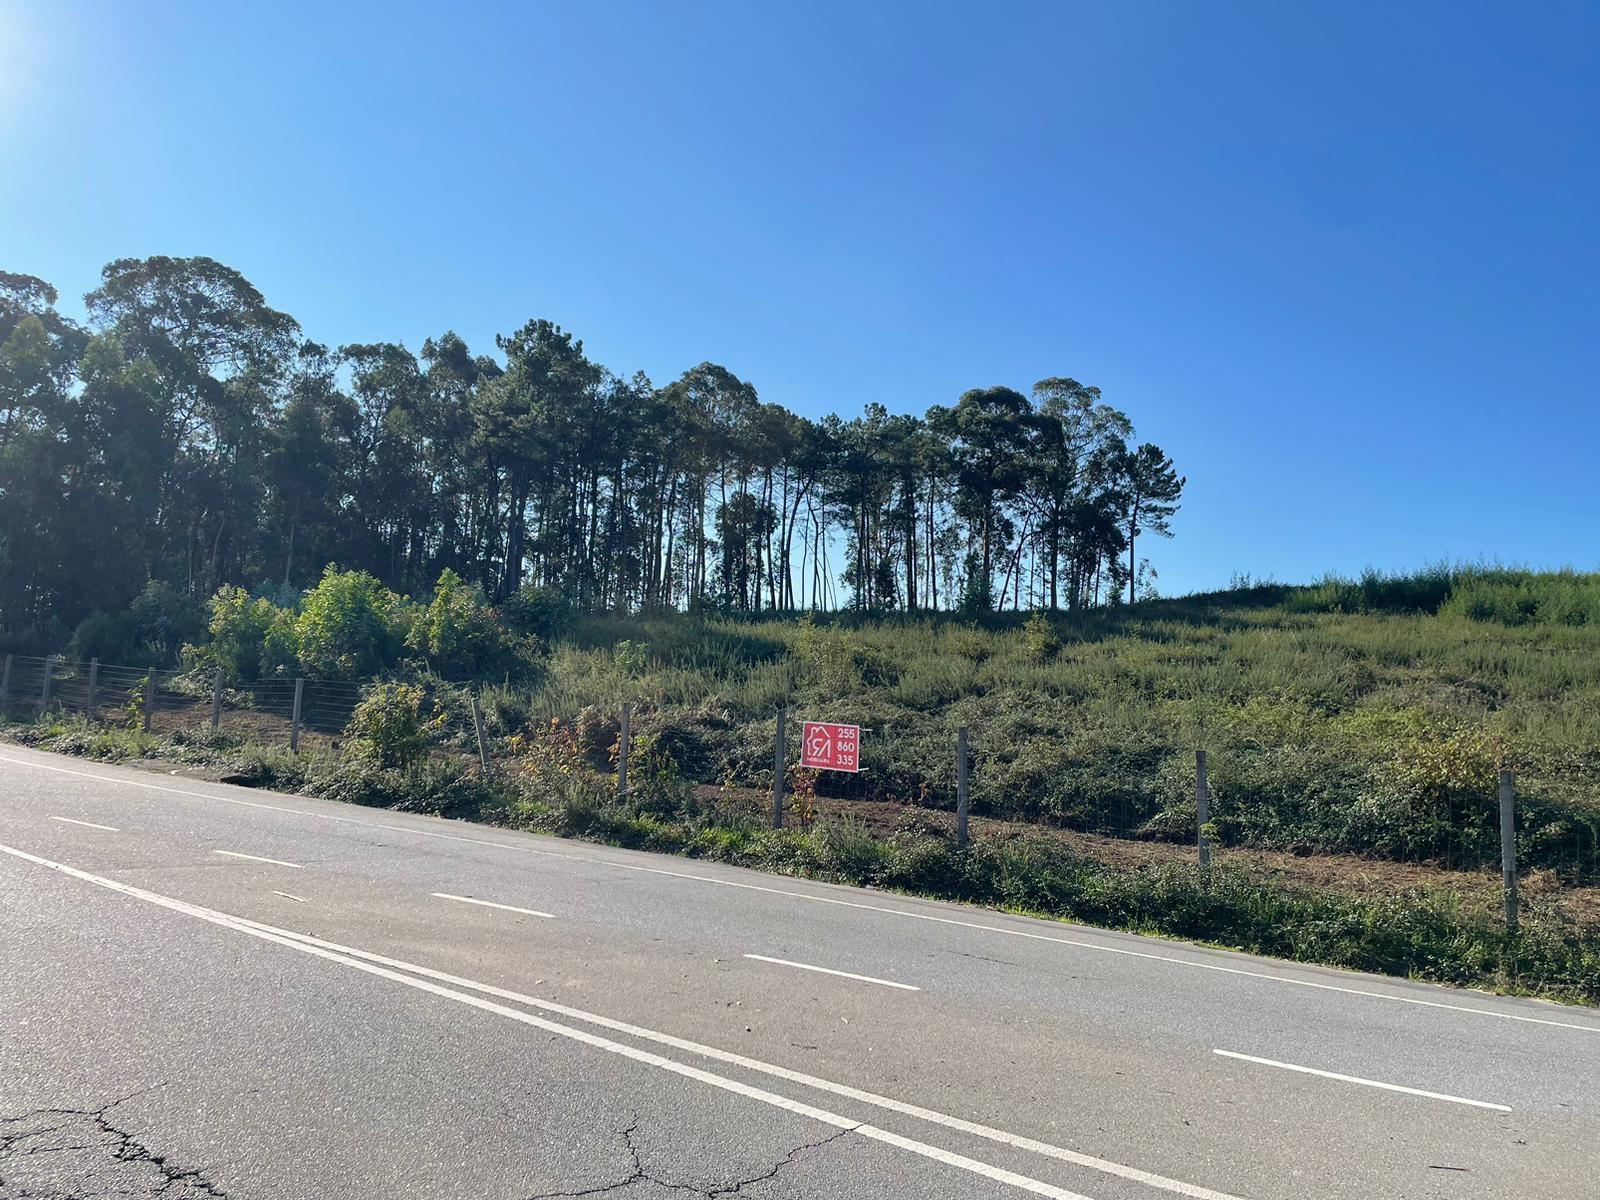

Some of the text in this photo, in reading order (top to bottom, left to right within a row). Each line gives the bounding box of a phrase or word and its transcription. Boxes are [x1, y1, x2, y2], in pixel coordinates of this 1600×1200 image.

[838, 728, 855, 739] 255
[837, 741, 855, 752] 860
[837, 755, 853, 765] 335
